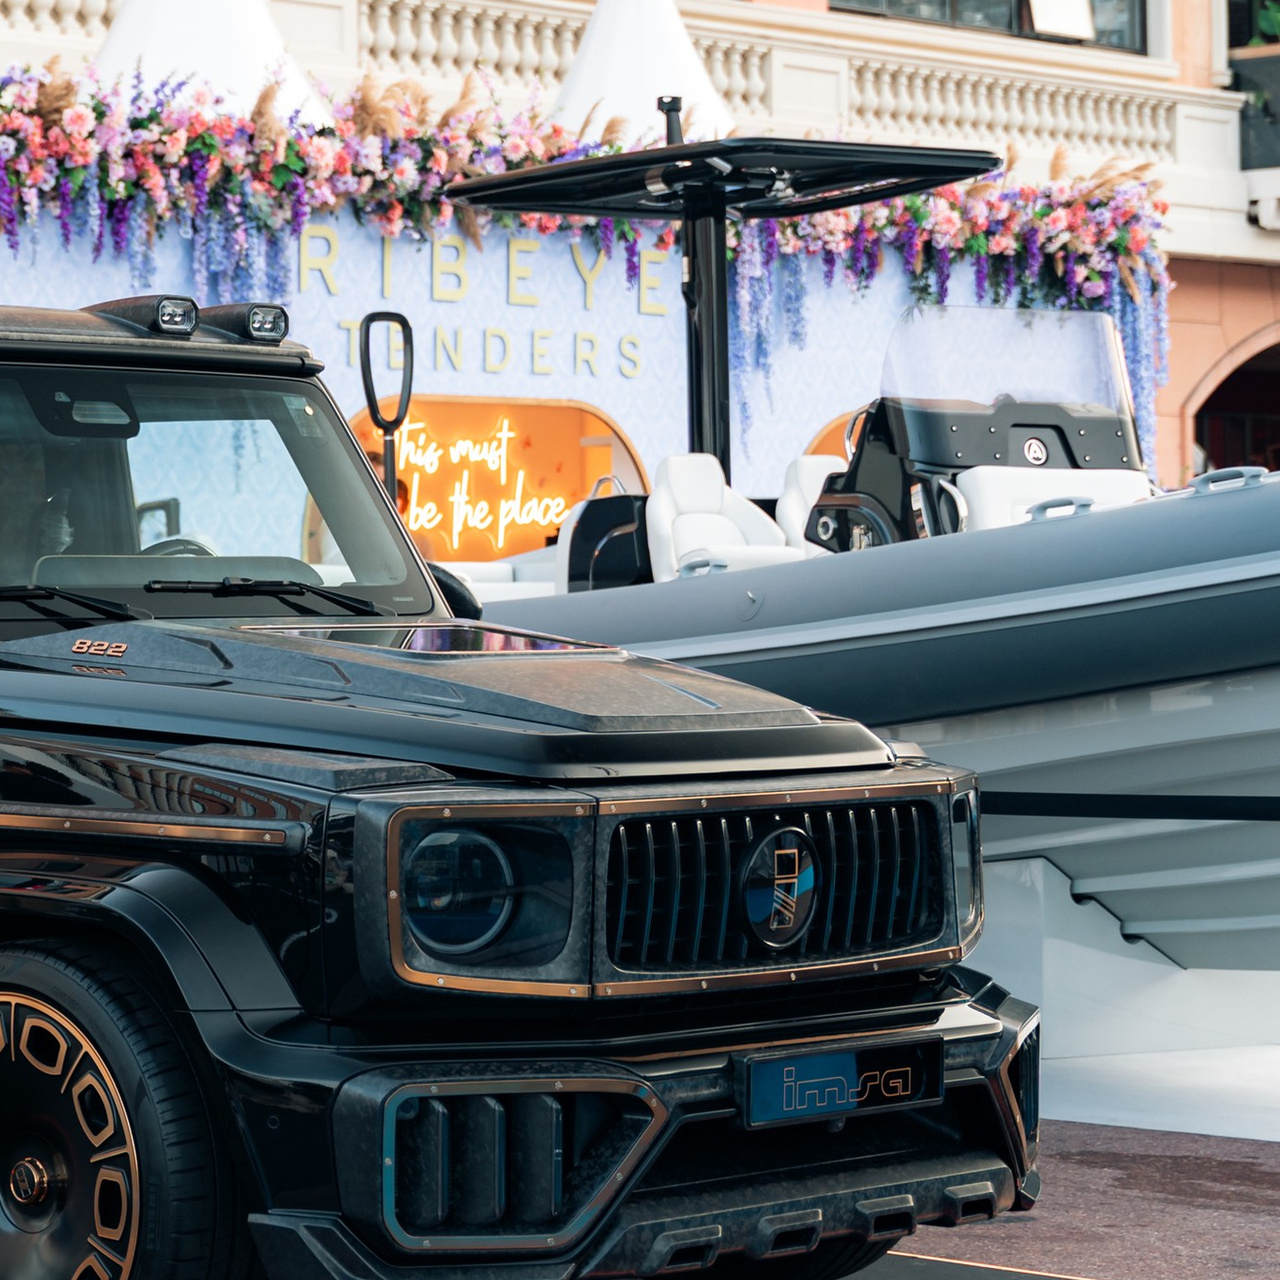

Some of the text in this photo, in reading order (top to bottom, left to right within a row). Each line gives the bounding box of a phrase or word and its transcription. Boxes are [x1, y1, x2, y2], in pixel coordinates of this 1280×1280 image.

[299, 223, 669, 316] RIBEYE
[338, 319, 642, 379] TENDERS
[448, 418, 516, 486] must
[408, 469, 572, 550] be the place
[71, 638, 129, 658] 822
[782, 1066, 912, 1112] imsa
